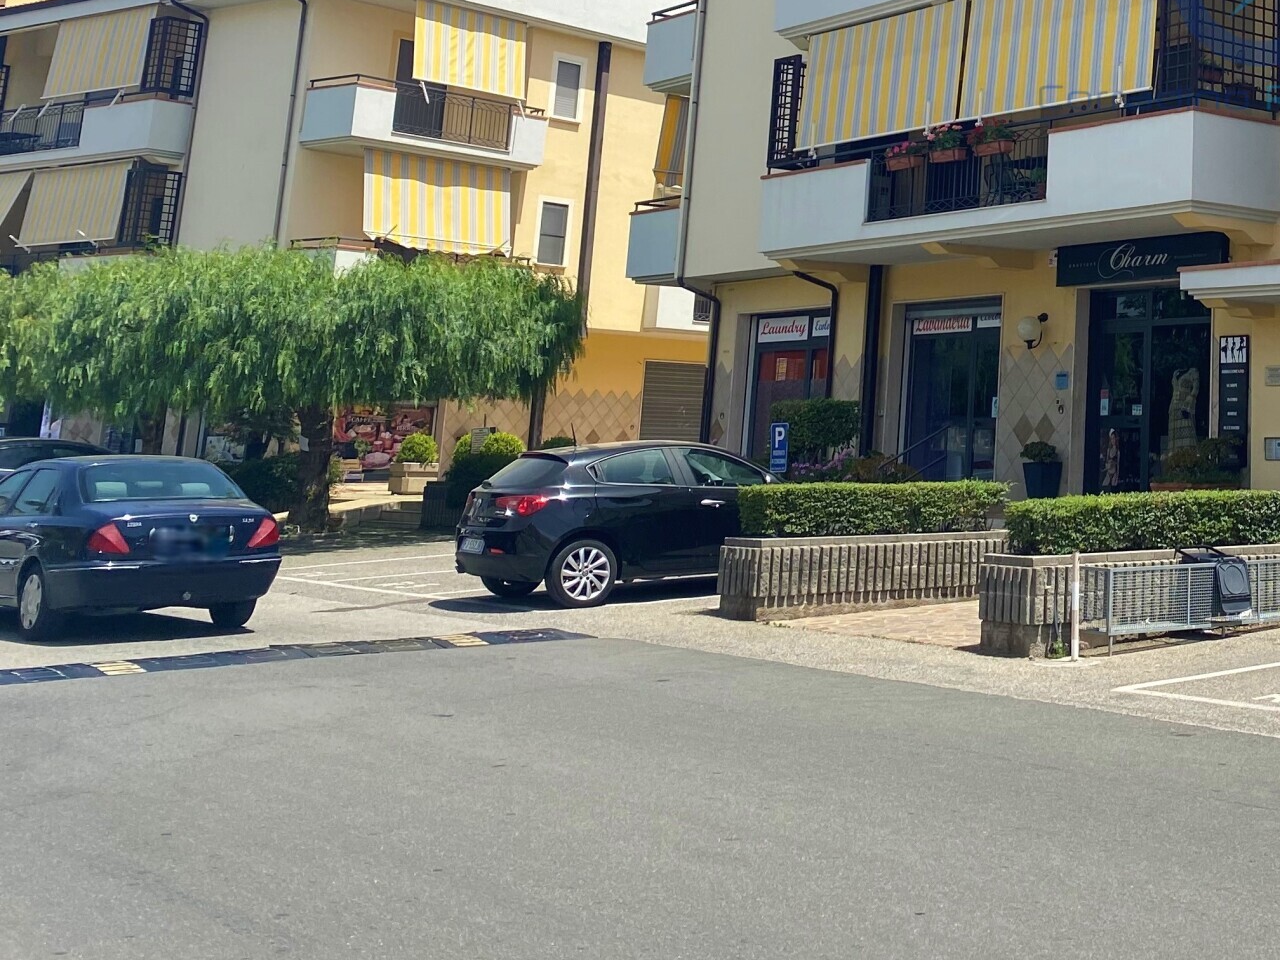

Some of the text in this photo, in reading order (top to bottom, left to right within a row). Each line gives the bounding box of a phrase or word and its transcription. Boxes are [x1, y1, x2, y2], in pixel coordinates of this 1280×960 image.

[1099, 242, 1171, 277] Charm
[760, 321, 807, 336] Laundry
[775, 427, 785, 448] P
